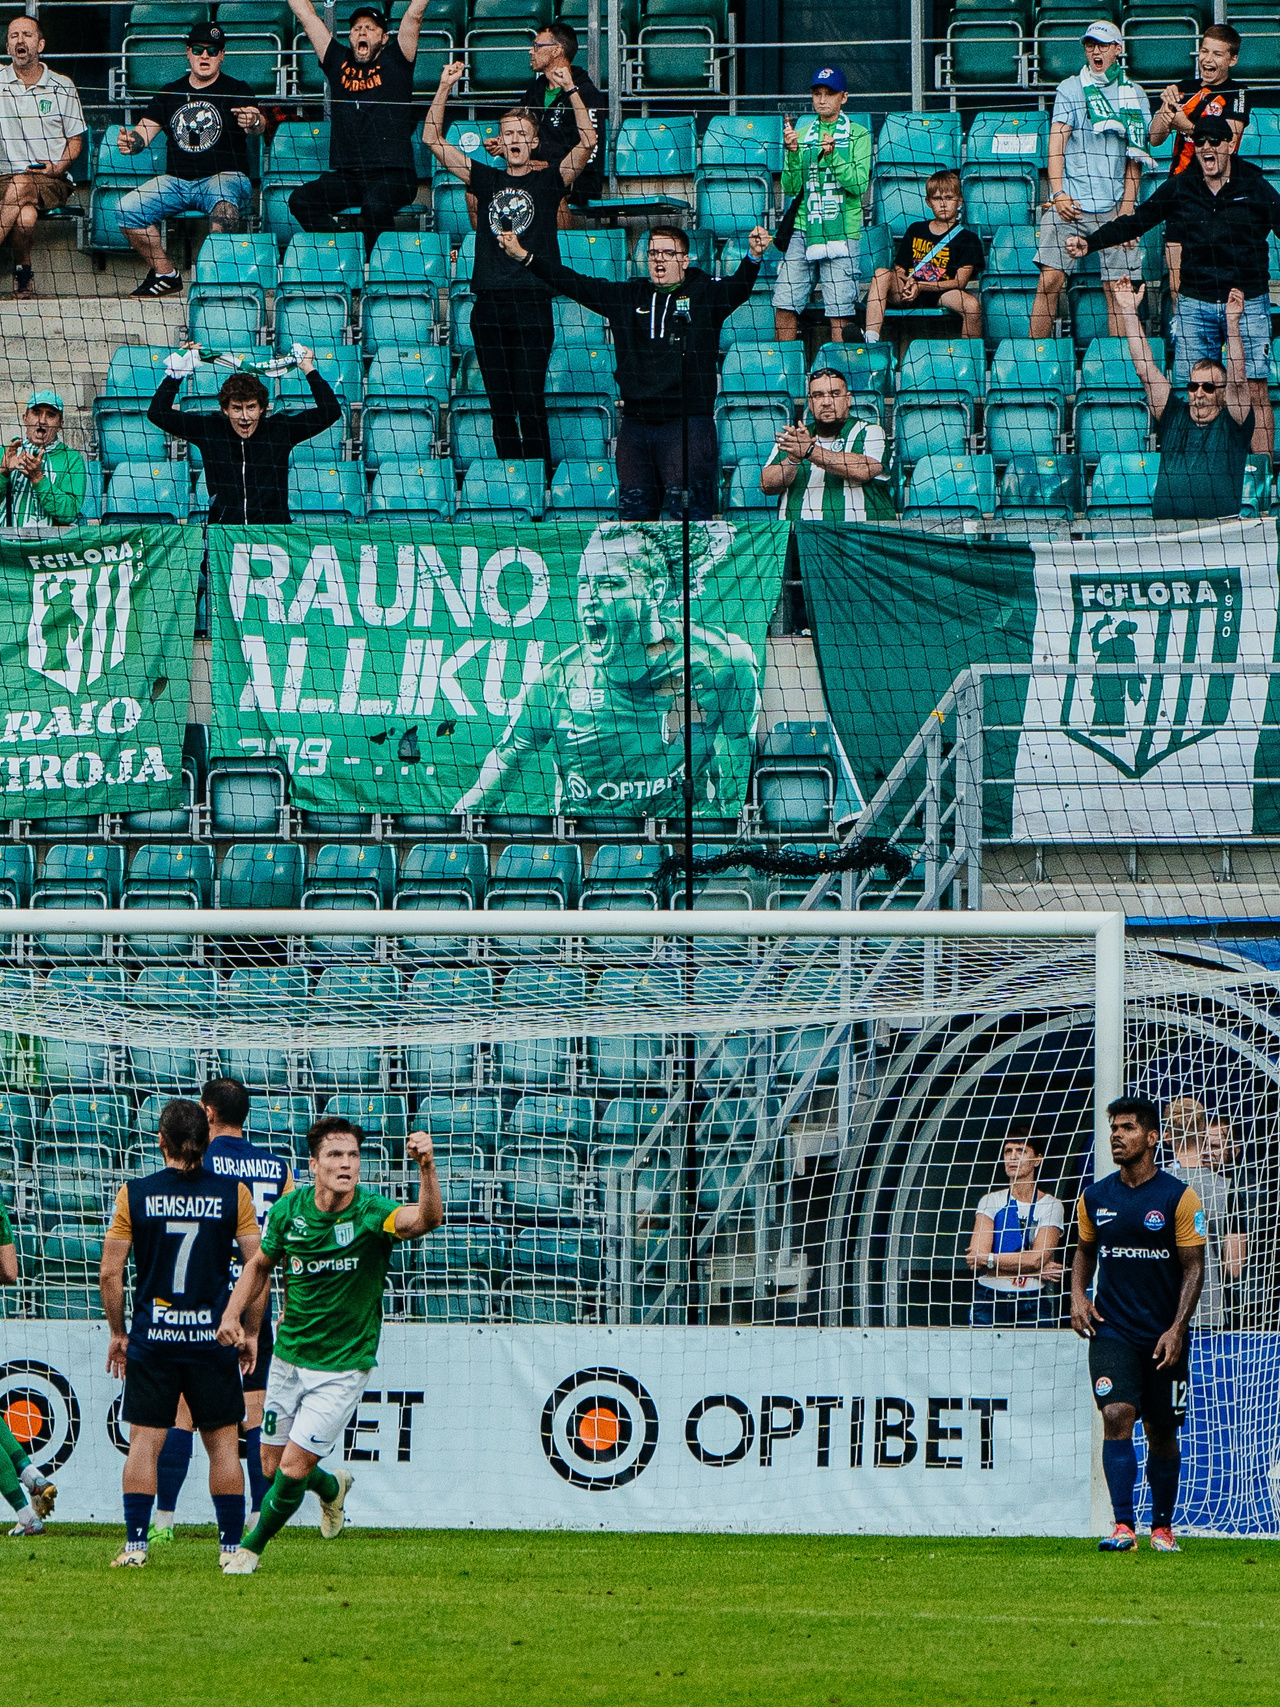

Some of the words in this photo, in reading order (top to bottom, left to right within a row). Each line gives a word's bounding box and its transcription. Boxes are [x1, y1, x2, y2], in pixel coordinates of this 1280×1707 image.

[229, 543, 550, 628] RAUNO
[1223, 578, 1235, 638] 1990
[239, 635, 545, 717] ALLIKU
[0, 697, 142, 743] RAIO
[212, 1156, 282, 1179] BURJANADZE
[145, 1195, 223, 1219] NEMSADZE
[166, 1222, 200, 1294] 7
[306, 1257, 360, 1274] OPTIBET
[1111, 1246, 1171, 1260] SPORTLAND
[152, 1306, 213, 1326] Fama
[147, 1328, 187, 1342] NARVA
[189, 1329, 218, 1342] LINN
[1172, 1379, 1188, 1408] 12
[261, 1409, 278, 1436] 8
[684, 1393, 1009, 1471] OPTIBET
[136, 1527, 143, 1537] 7
[219, 1531, 226, 1540] 7
